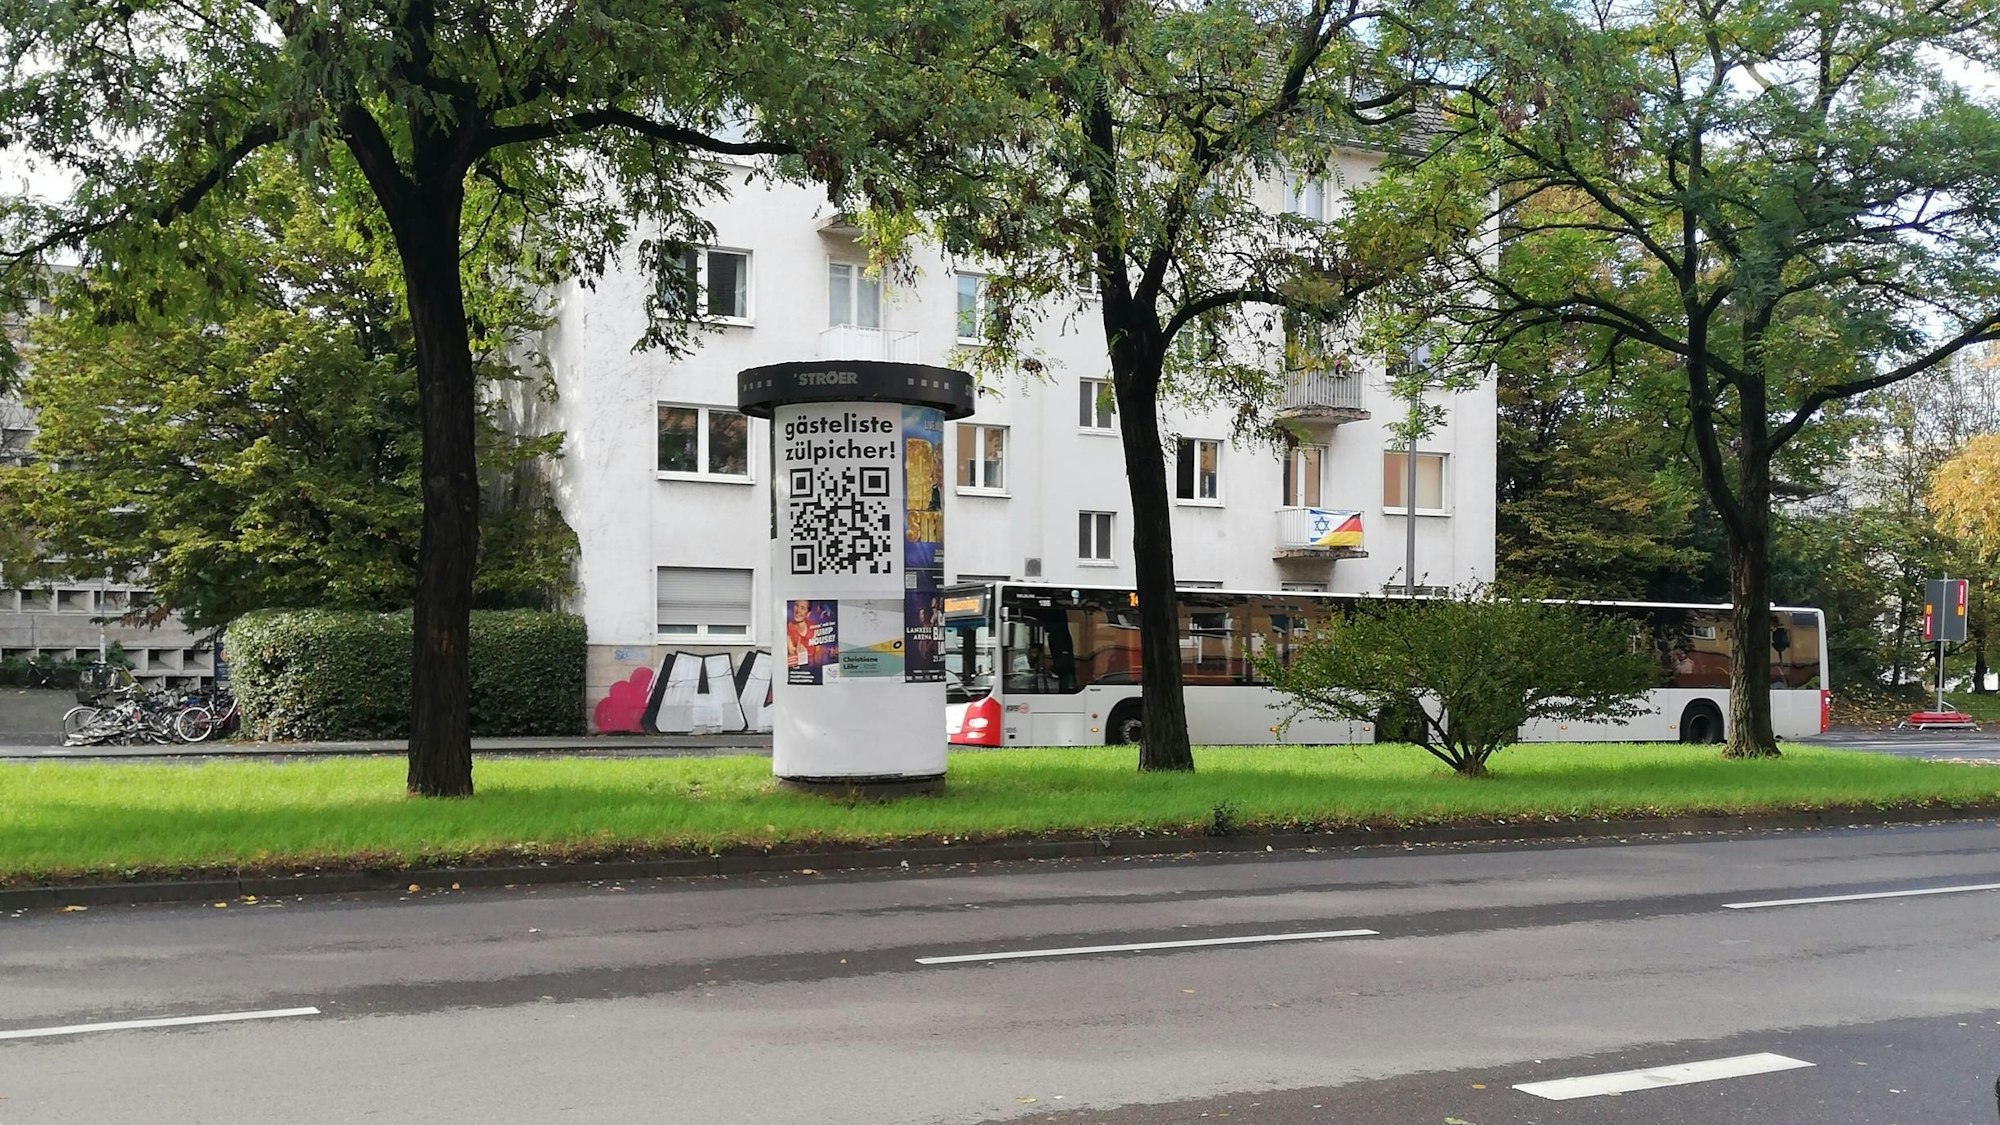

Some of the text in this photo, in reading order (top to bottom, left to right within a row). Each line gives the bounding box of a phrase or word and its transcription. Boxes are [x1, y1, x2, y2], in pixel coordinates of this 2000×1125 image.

[785, 412, 893, 441] gästeliste
[785, 438, 896, 465] zülpicher!
[808, 634, 836, 647] HOUSE!
[813, 626, 834, 638] JUMP
